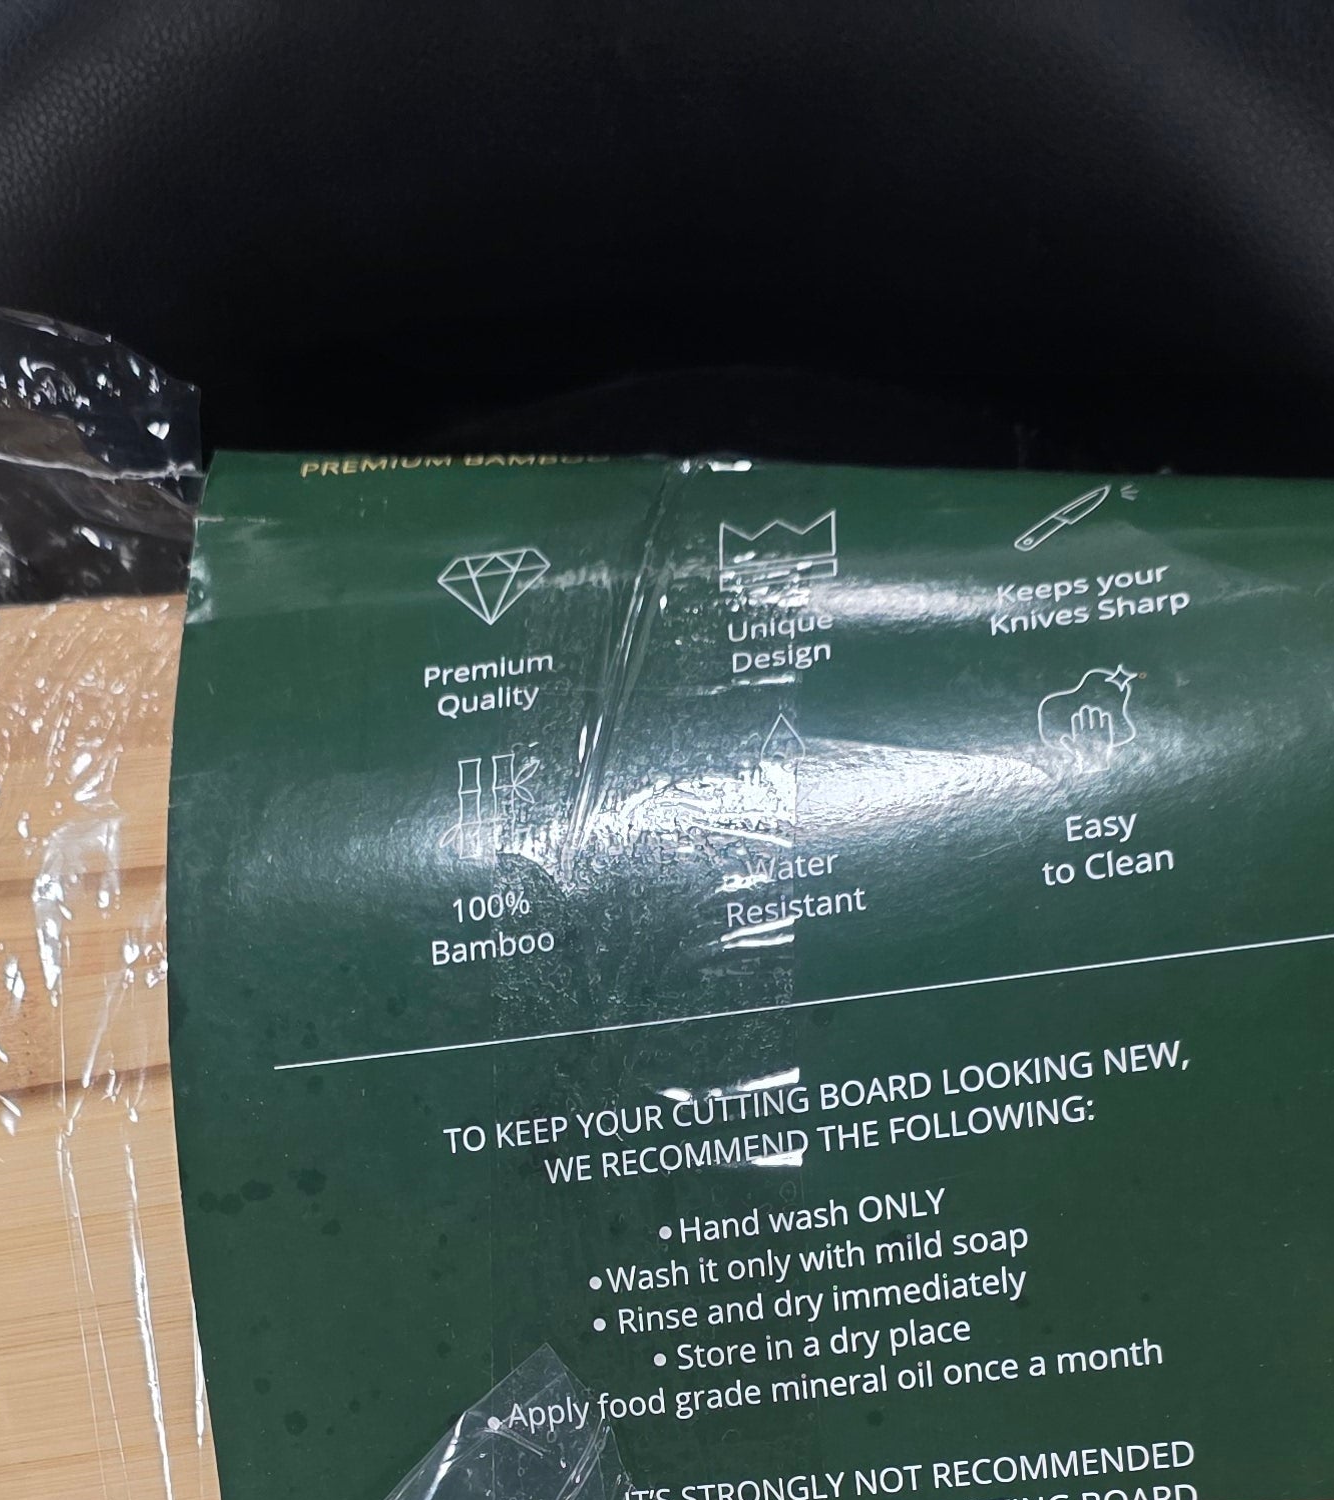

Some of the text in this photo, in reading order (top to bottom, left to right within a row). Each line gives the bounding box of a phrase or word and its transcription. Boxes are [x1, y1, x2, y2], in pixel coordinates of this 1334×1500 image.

[300, 455, 452, 478] PREMIUM
[997, 565, 1168, 605] Keeps your
[728, 612, 834, 643] Unique
[991, 590, 1190, 637] Knives Sharp
[424, 652, 554, 689] Premium
[732, 643, 832, 674] Design
[437, 685, 540, 720] Quality
[1066, 810, 1137, 847] Easy
[1043, 845, 1175, 888] to Clean
[451, 889, 531, 925] 100%
[726, 887, 867, 928] Resistant
[431, 927, 555, 966] Bamboo
[443, 1040, 1190, 1154] TO KEEP YOUR CUTTING BOARD LOOKING NEW,
[544, 1095, 1094, 1184] WE RECOMMEND THE FOLLOWING:
[679, 1187, 945, 1243] Hand wash ONLY
[606, 1227, 1028, 1293] Wash it only with mild soap
[618, 1266, 1026, 1334] Rinse and dry immediately
[677, 1319, 971, 1370] Store in a dry place
[508, 1338, 1163, 1433] Apply food grade mineral oil once a month
[854, 1465, 923, 1496] NOT
[933, 1440, 1194, 1489] RECOMMENDED
